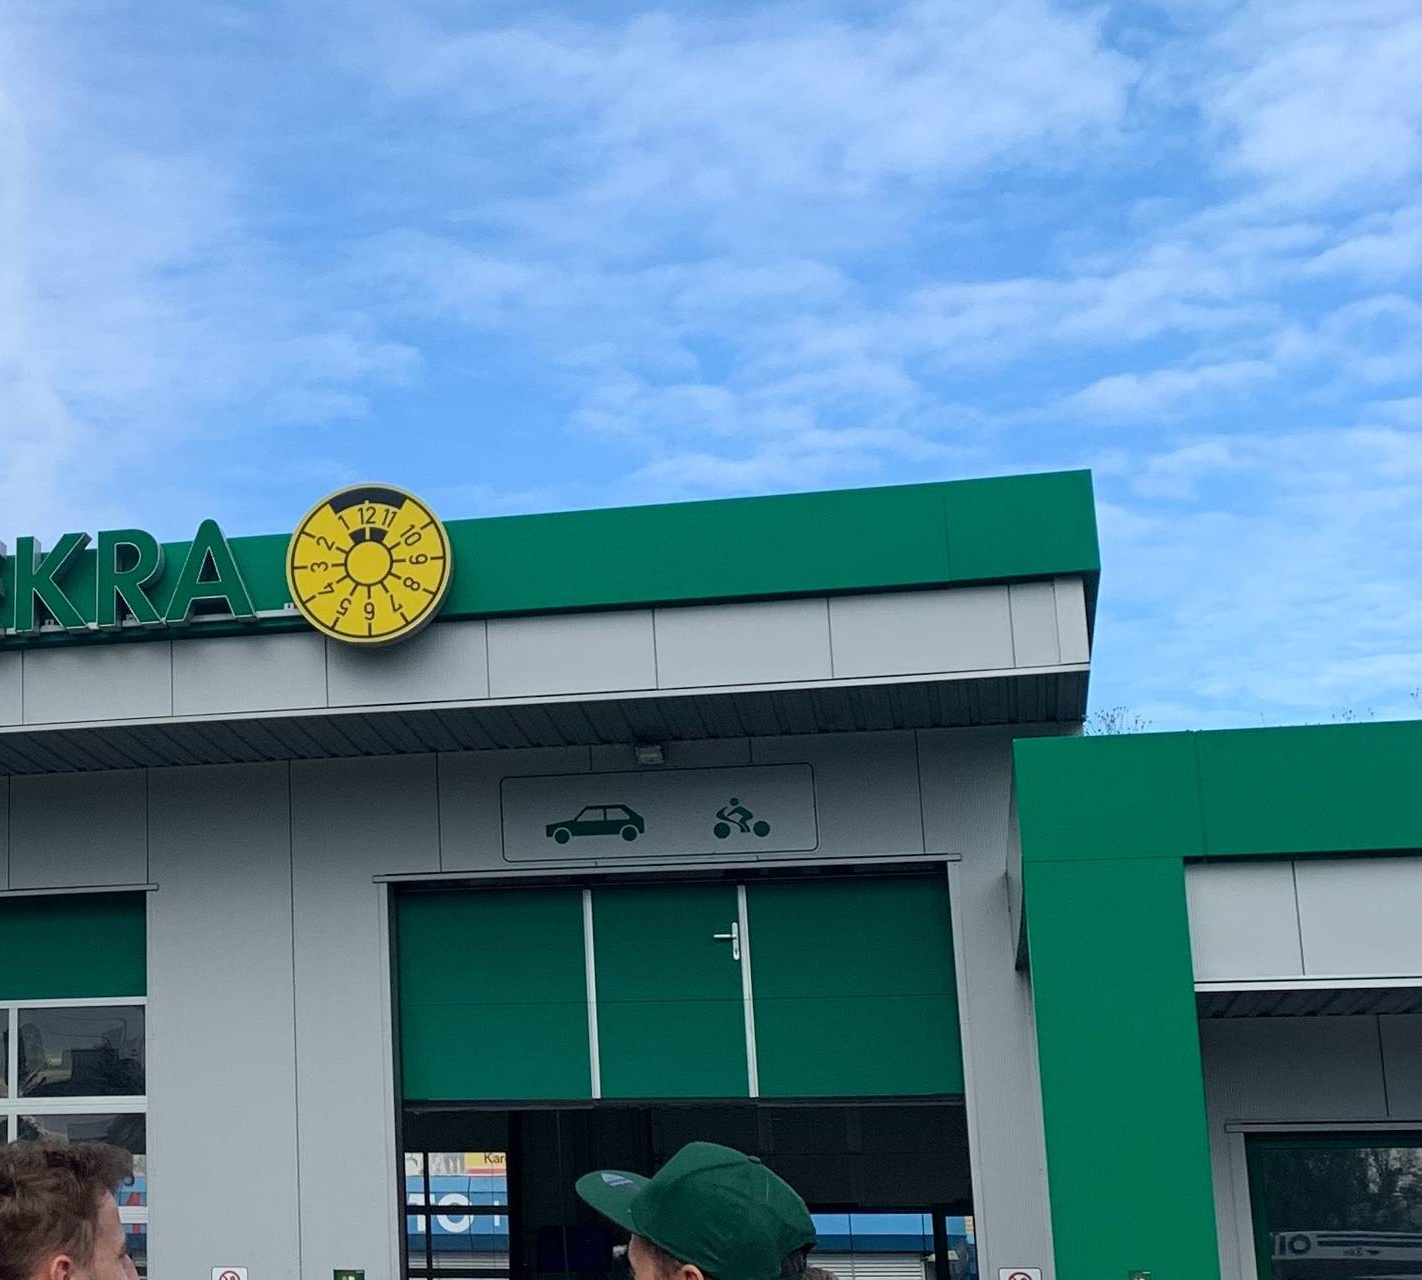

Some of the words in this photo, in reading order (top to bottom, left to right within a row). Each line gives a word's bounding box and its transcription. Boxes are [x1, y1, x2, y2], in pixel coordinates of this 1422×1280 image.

[338, 515, 350, 531] 1
[357, 506, 377, 525] 12
[381, 508, 398, 528] 11
[316, 535, 335, 551] 2
[400, 523, 422, 547] 10
[309, 561, 329, 573] 3
[409, 553, 428, 565] 9
[317, 581, 335, 595] 4
[403, 576, 421, 592] 8
[336, 597, 352, 617] 5
[364, 602, 376, 621] 6
[389, 594, 403, 613] 7
[483, 1152, 507, 1164] Kar
